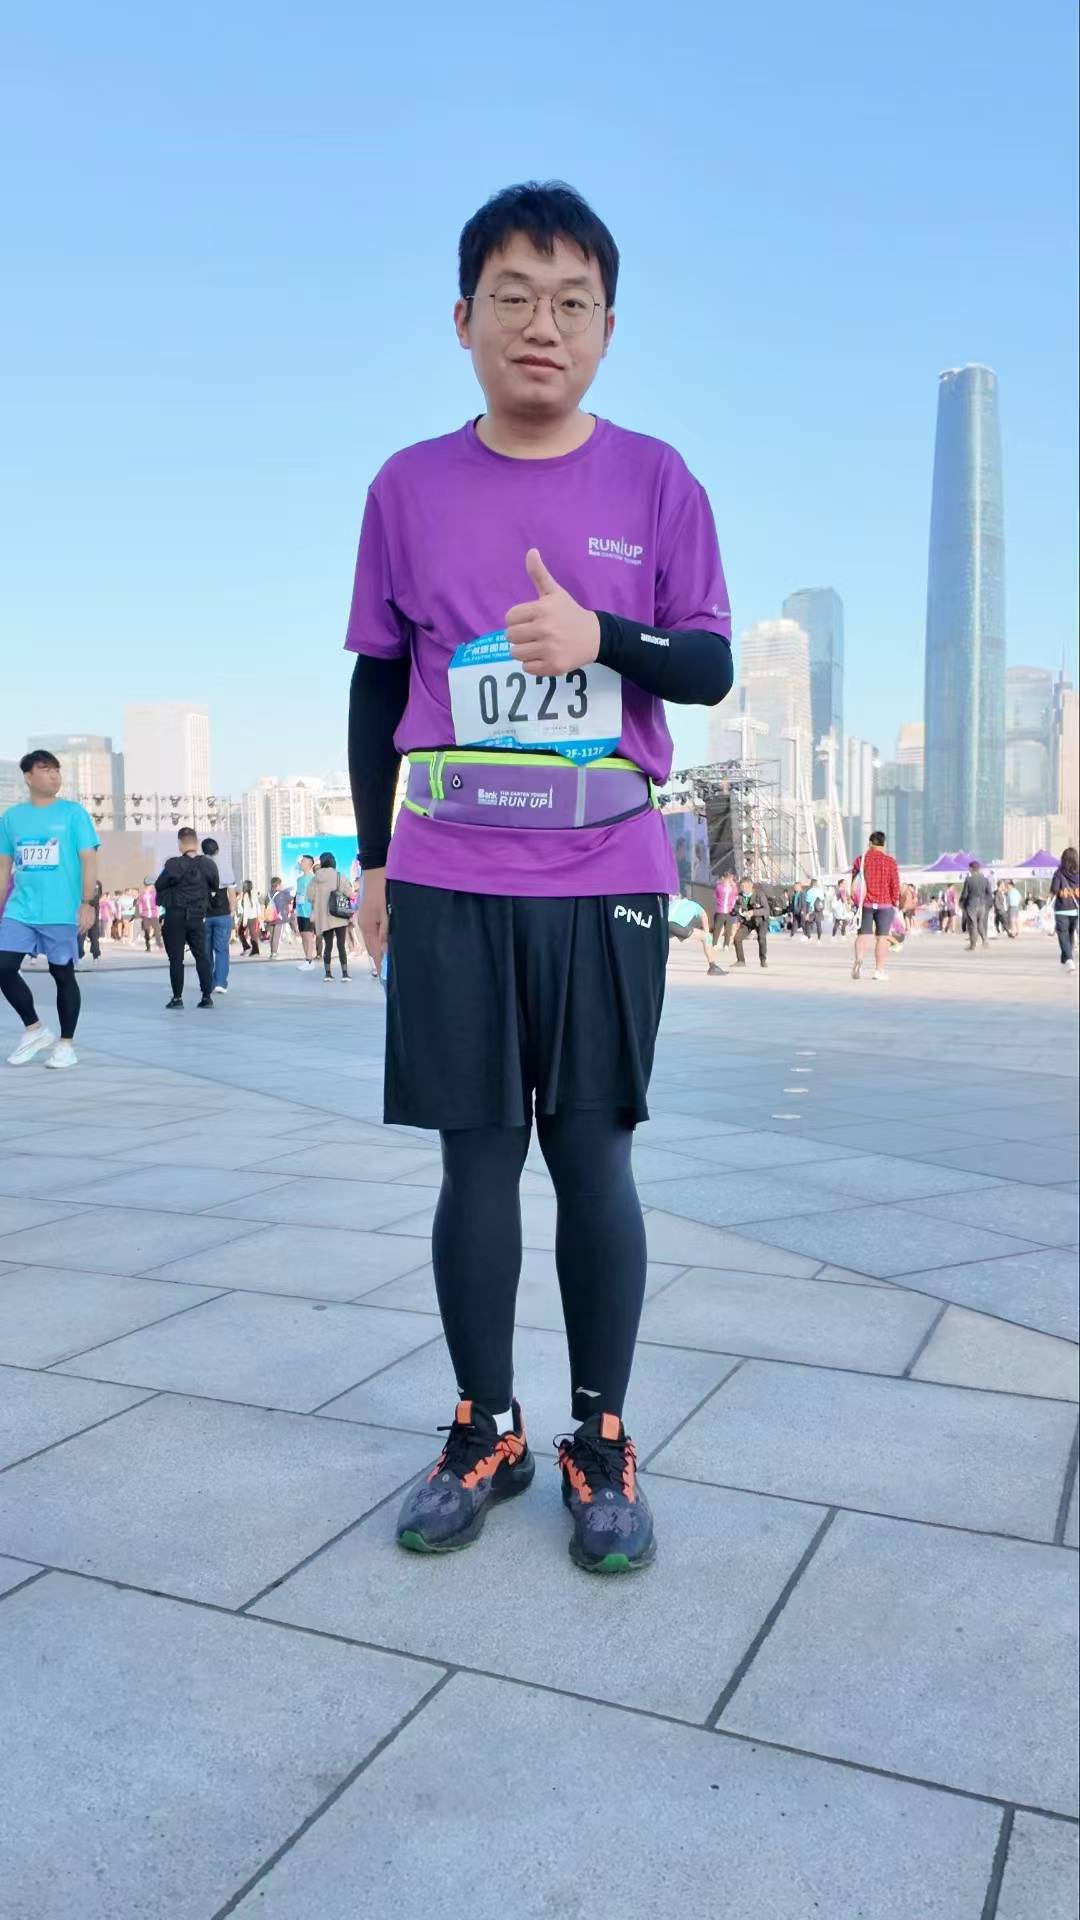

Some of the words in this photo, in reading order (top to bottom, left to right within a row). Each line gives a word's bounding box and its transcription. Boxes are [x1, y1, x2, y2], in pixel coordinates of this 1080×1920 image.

[588, 537, 620, 554] RUN
[624, 543, 644, 558] UP
[479, 668, 588, 725] 0223
[478, 788, 498, 799] Bank
[498, 796, 526, 807] RUN
[530, 798, 548, 808] UP
[23, 848, 50, 860] 0737
